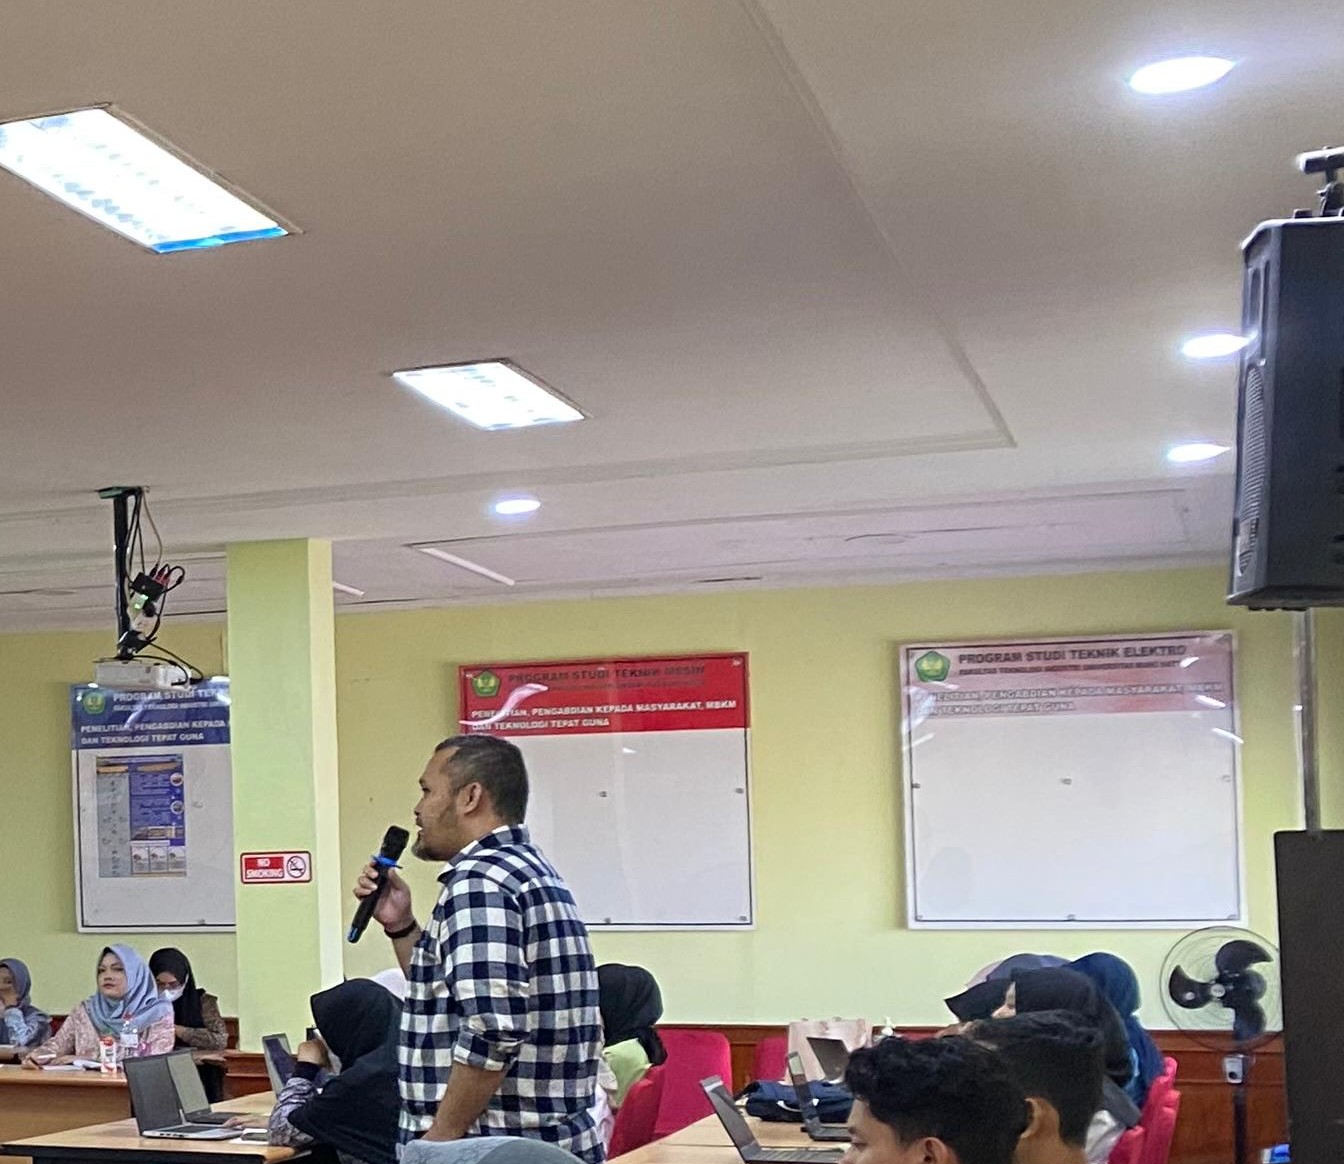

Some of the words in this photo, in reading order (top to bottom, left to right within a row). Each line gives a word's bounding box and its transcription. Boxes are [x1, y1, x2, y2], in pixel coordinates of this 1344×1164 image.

[958, 652, 1023, 665] PROGRAM
[1026, 650, 1066, 662] STUDI
[1070, 648, 1121, 660] TEKNIK
[113, 692, 161, 701] PROGRAM
